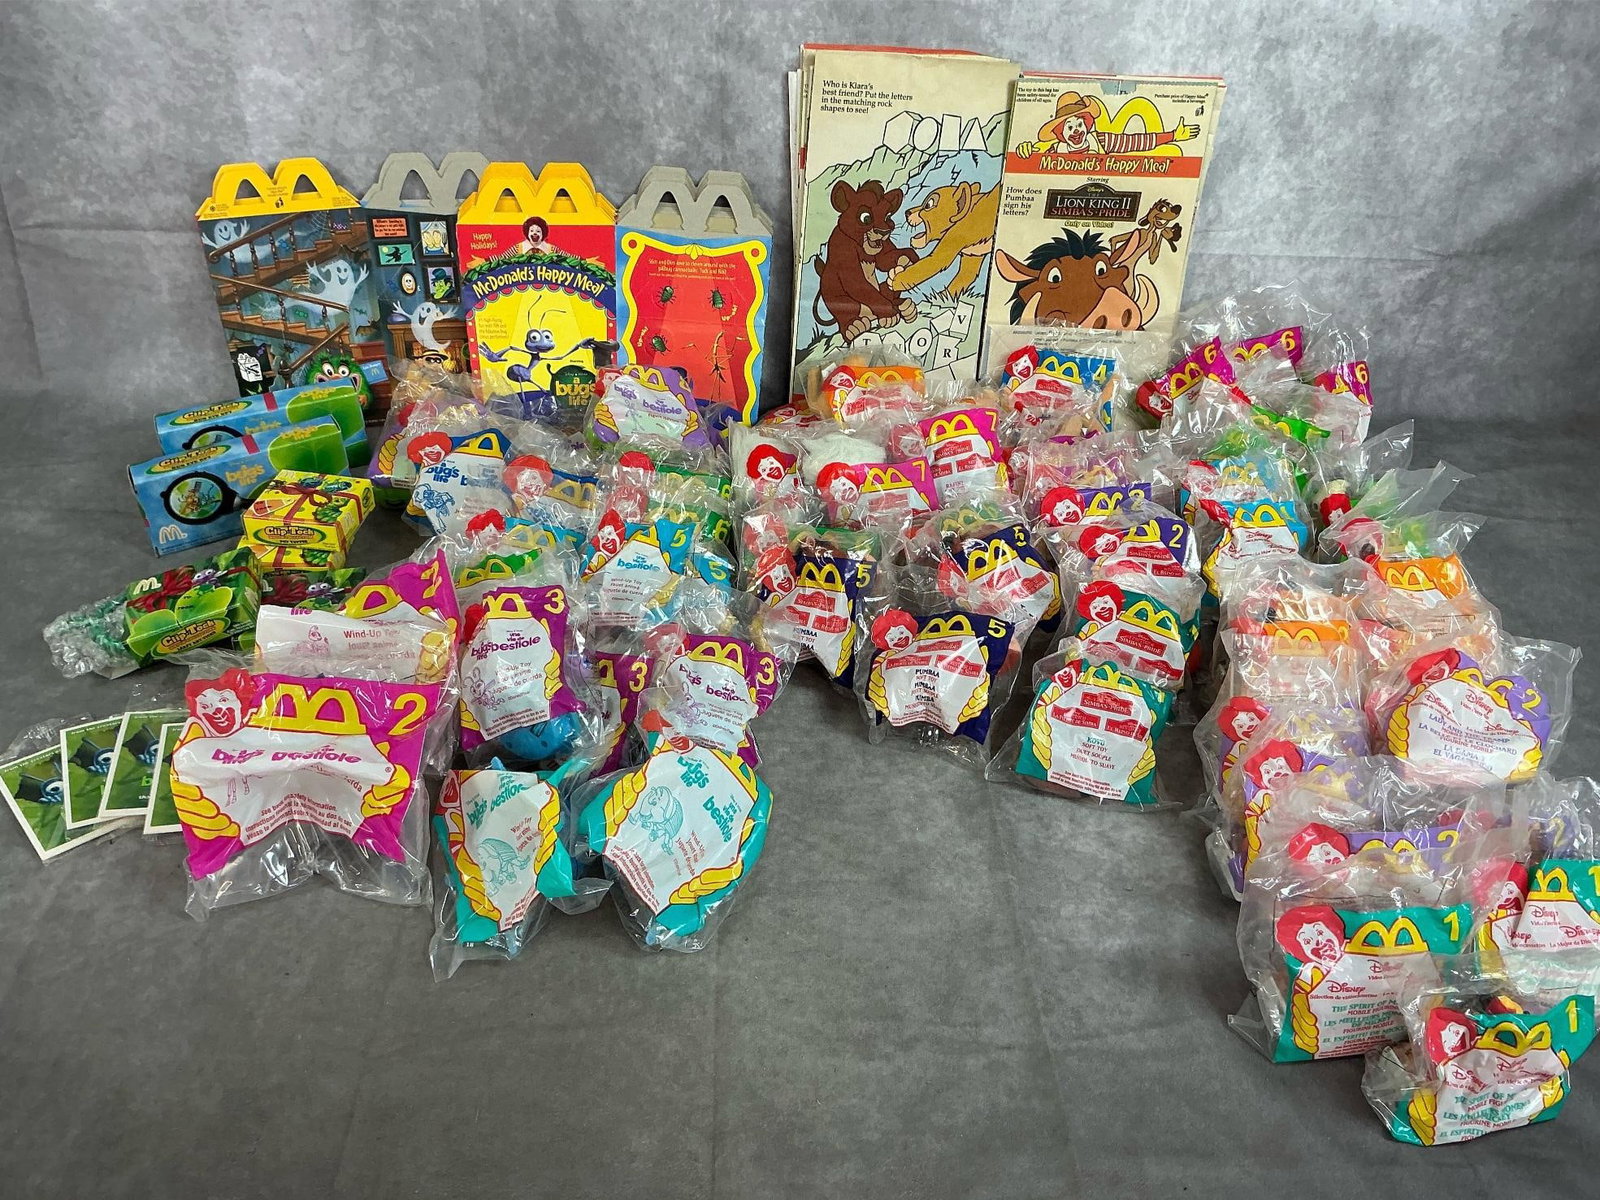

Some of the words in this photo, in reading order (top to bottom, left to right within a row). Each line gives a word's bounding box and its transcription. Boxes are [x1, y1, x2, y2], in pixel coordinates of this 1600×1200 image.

[823, 80, 840, 88] Who
[849, 82, 873, 90] Kiara's
[838, 89, 863, 98] friend?
[891, 92, 913, 100] letters
[821, 105, 844, 114] shapes
[843, 98, 875, 108] matching
[877, 99, 892, 107] rock
[1106, 159, 1139, 173] Happy
[1143, 160, 1170, 173] Meal
[1056, 196, 1086, 208] LION
[1088, 198, 1119, 208] KING
[1122, 198, 1131, 208] II
[1100, 209, 1130, 217] PRIDE
[471, 241, 497, 250] Holidays!
[472, 267, 534, 299] McDonald's
[537, 266, 574, 285] Happy
[573, 274, 605, 297] Meal
[1281, 330, 1296, 351] 6
[1204, 344, 1217, 364] 6
[1355, 364, 1368, 384] 6
[568, 396, 588, 406] life
[433, 474, 448, 483] life
[912, 460, 925, 481] 7
[670, 528, 689, 548] 5
[1169, 525, 1184, 548] 2
[708, 562, 727, 580] 5
[856, 564, 872, 588] 5
[544, 588, 566, 615] 3
[343, 629, 382, 639] Wind-Up
[988, 618, 1006, 638] 5
[630, 661, 648, 692] 3
[758, 657, 775, 685] 3
[915, 669, 940, 678] PUMBAA
[1522, 689, 1541, 710] 2
[388, 692, 427, 735] 2
[677, 755, 710, 790] bug's
[261, 808, 271, 816] See
[1444, 912, 1459, 941] 1
[1326, 980, 1365, 995] Disney
[1332, 1004, 1348, 1012] THE
[1565, 1000, 1578, 1033] 1
[1443, 1111, 1458, 1119] LES
